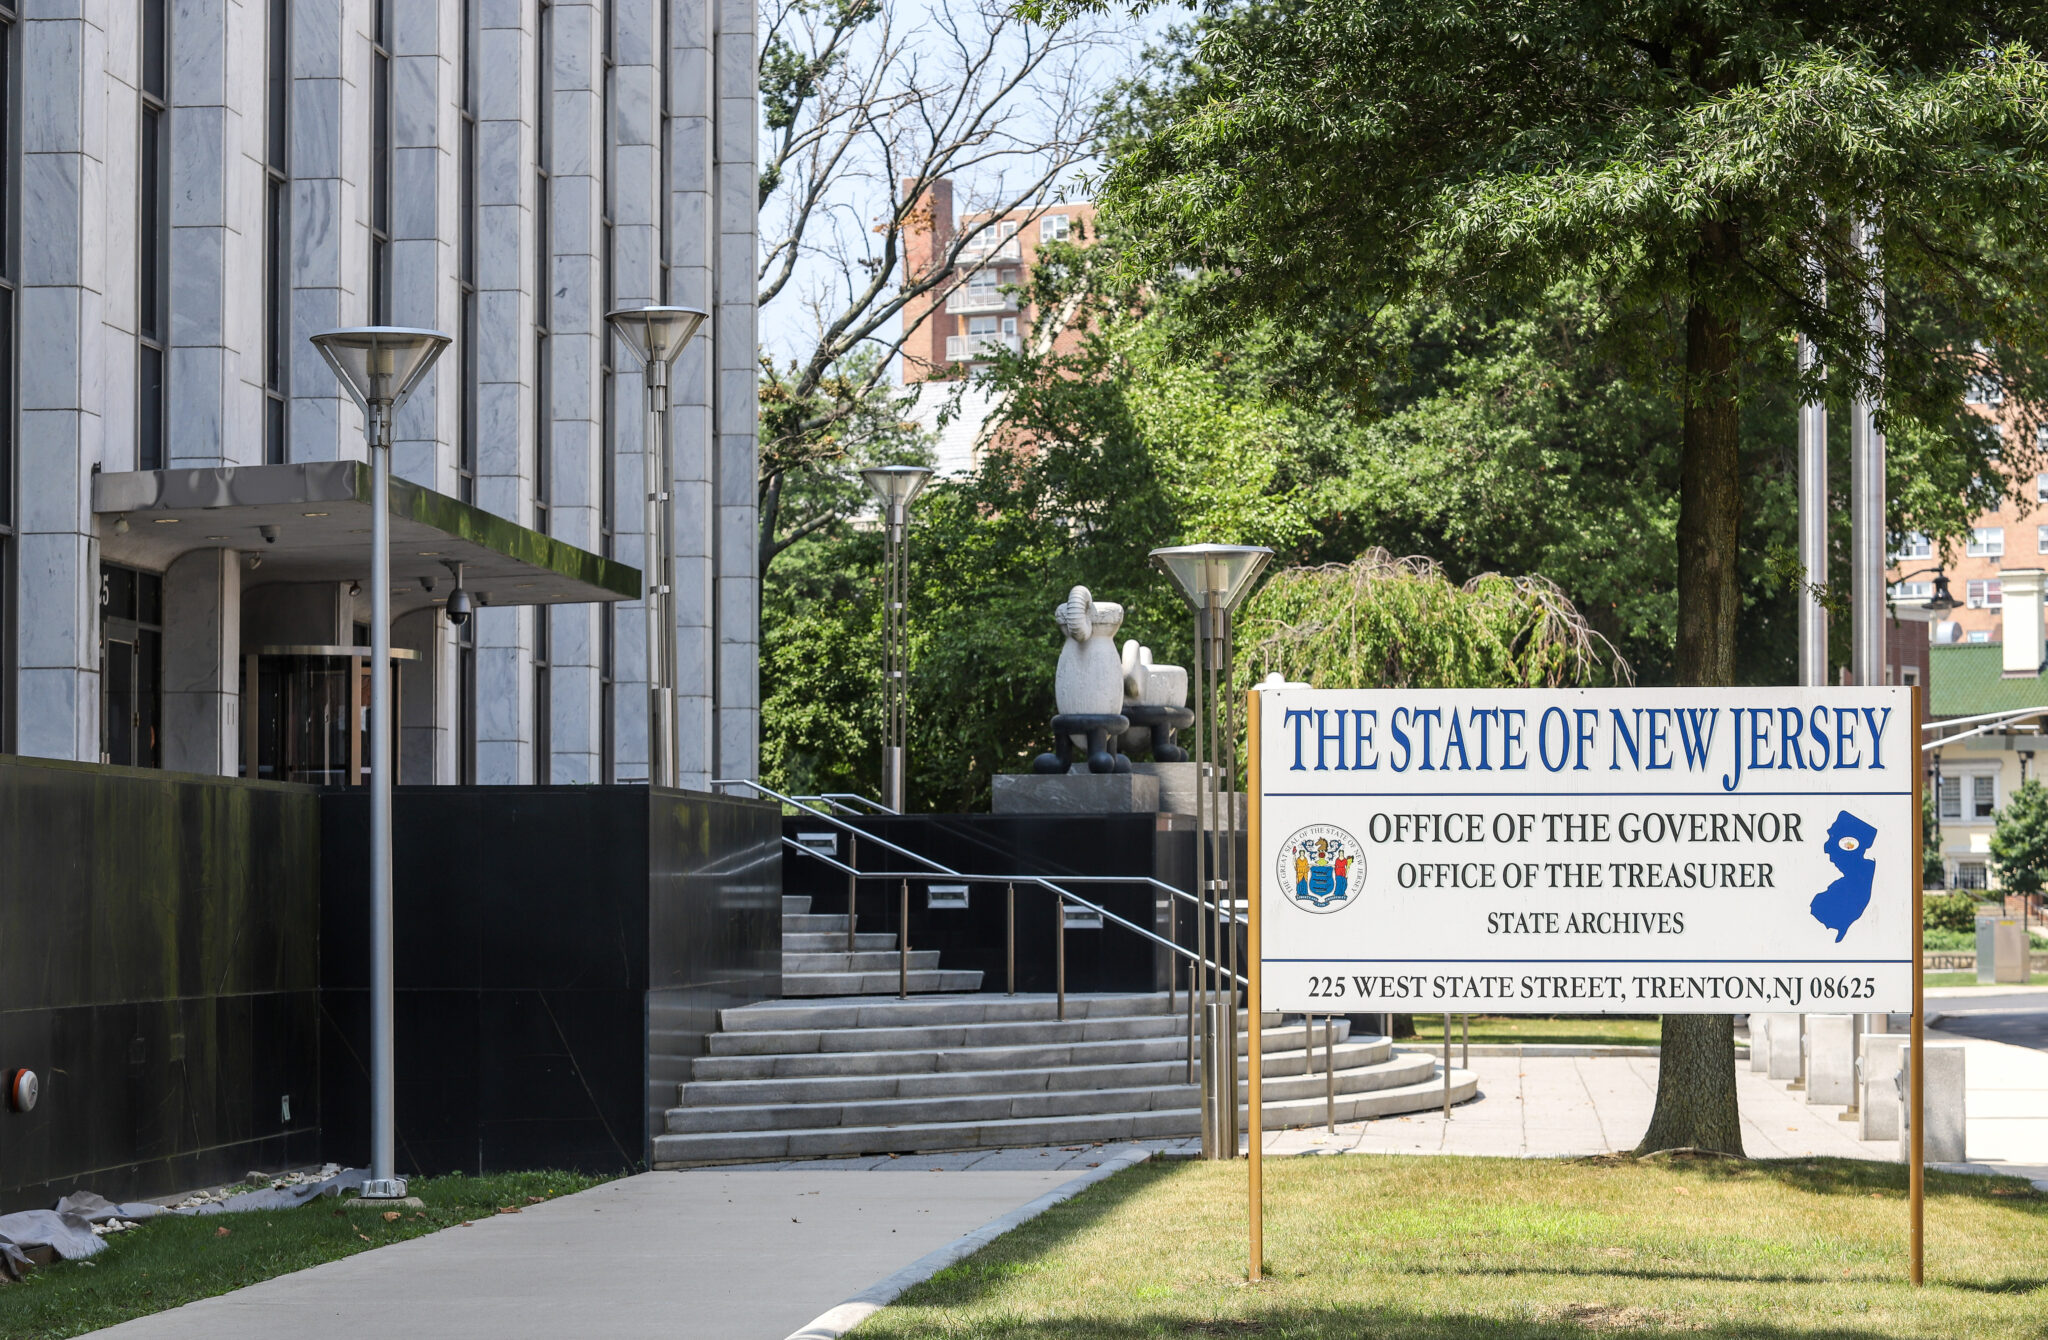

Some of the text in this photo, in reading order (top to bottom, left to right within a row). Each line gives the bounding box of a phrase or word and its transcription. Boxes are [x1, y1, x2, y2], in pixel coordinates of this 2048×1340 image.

[1284, 704, 1892, 792] THE STATE OF NEW JERSEY
[1299, 831, 1309, 839] OF
[1326, 828, 1348, 841] STATE
[1368, 812, 1804, 844] OFFICE OF THE GOVERNOR
[1285, 837, 1299, 852] SEAL
[1347, 839, 1357, 849] OF
[1280, 854, 1288, 879] GREAT
[1354, 849, 1363, 865] NEW
[1397, 862, 1776, 889] OFFICE OF THE TREASURER
[1283, 880, 1293, 893] THE
[1487, 911, 1685, 935] STATE ARCHIVES
[1308, 976, 1346, 998] 225
[1352, 975, 1427, 999] WEST
[1432, 975, 1515, 999] STATE
[1520, 975, 1626, 1003] STREET,
[1809, 975, 1875, 999] 08625
